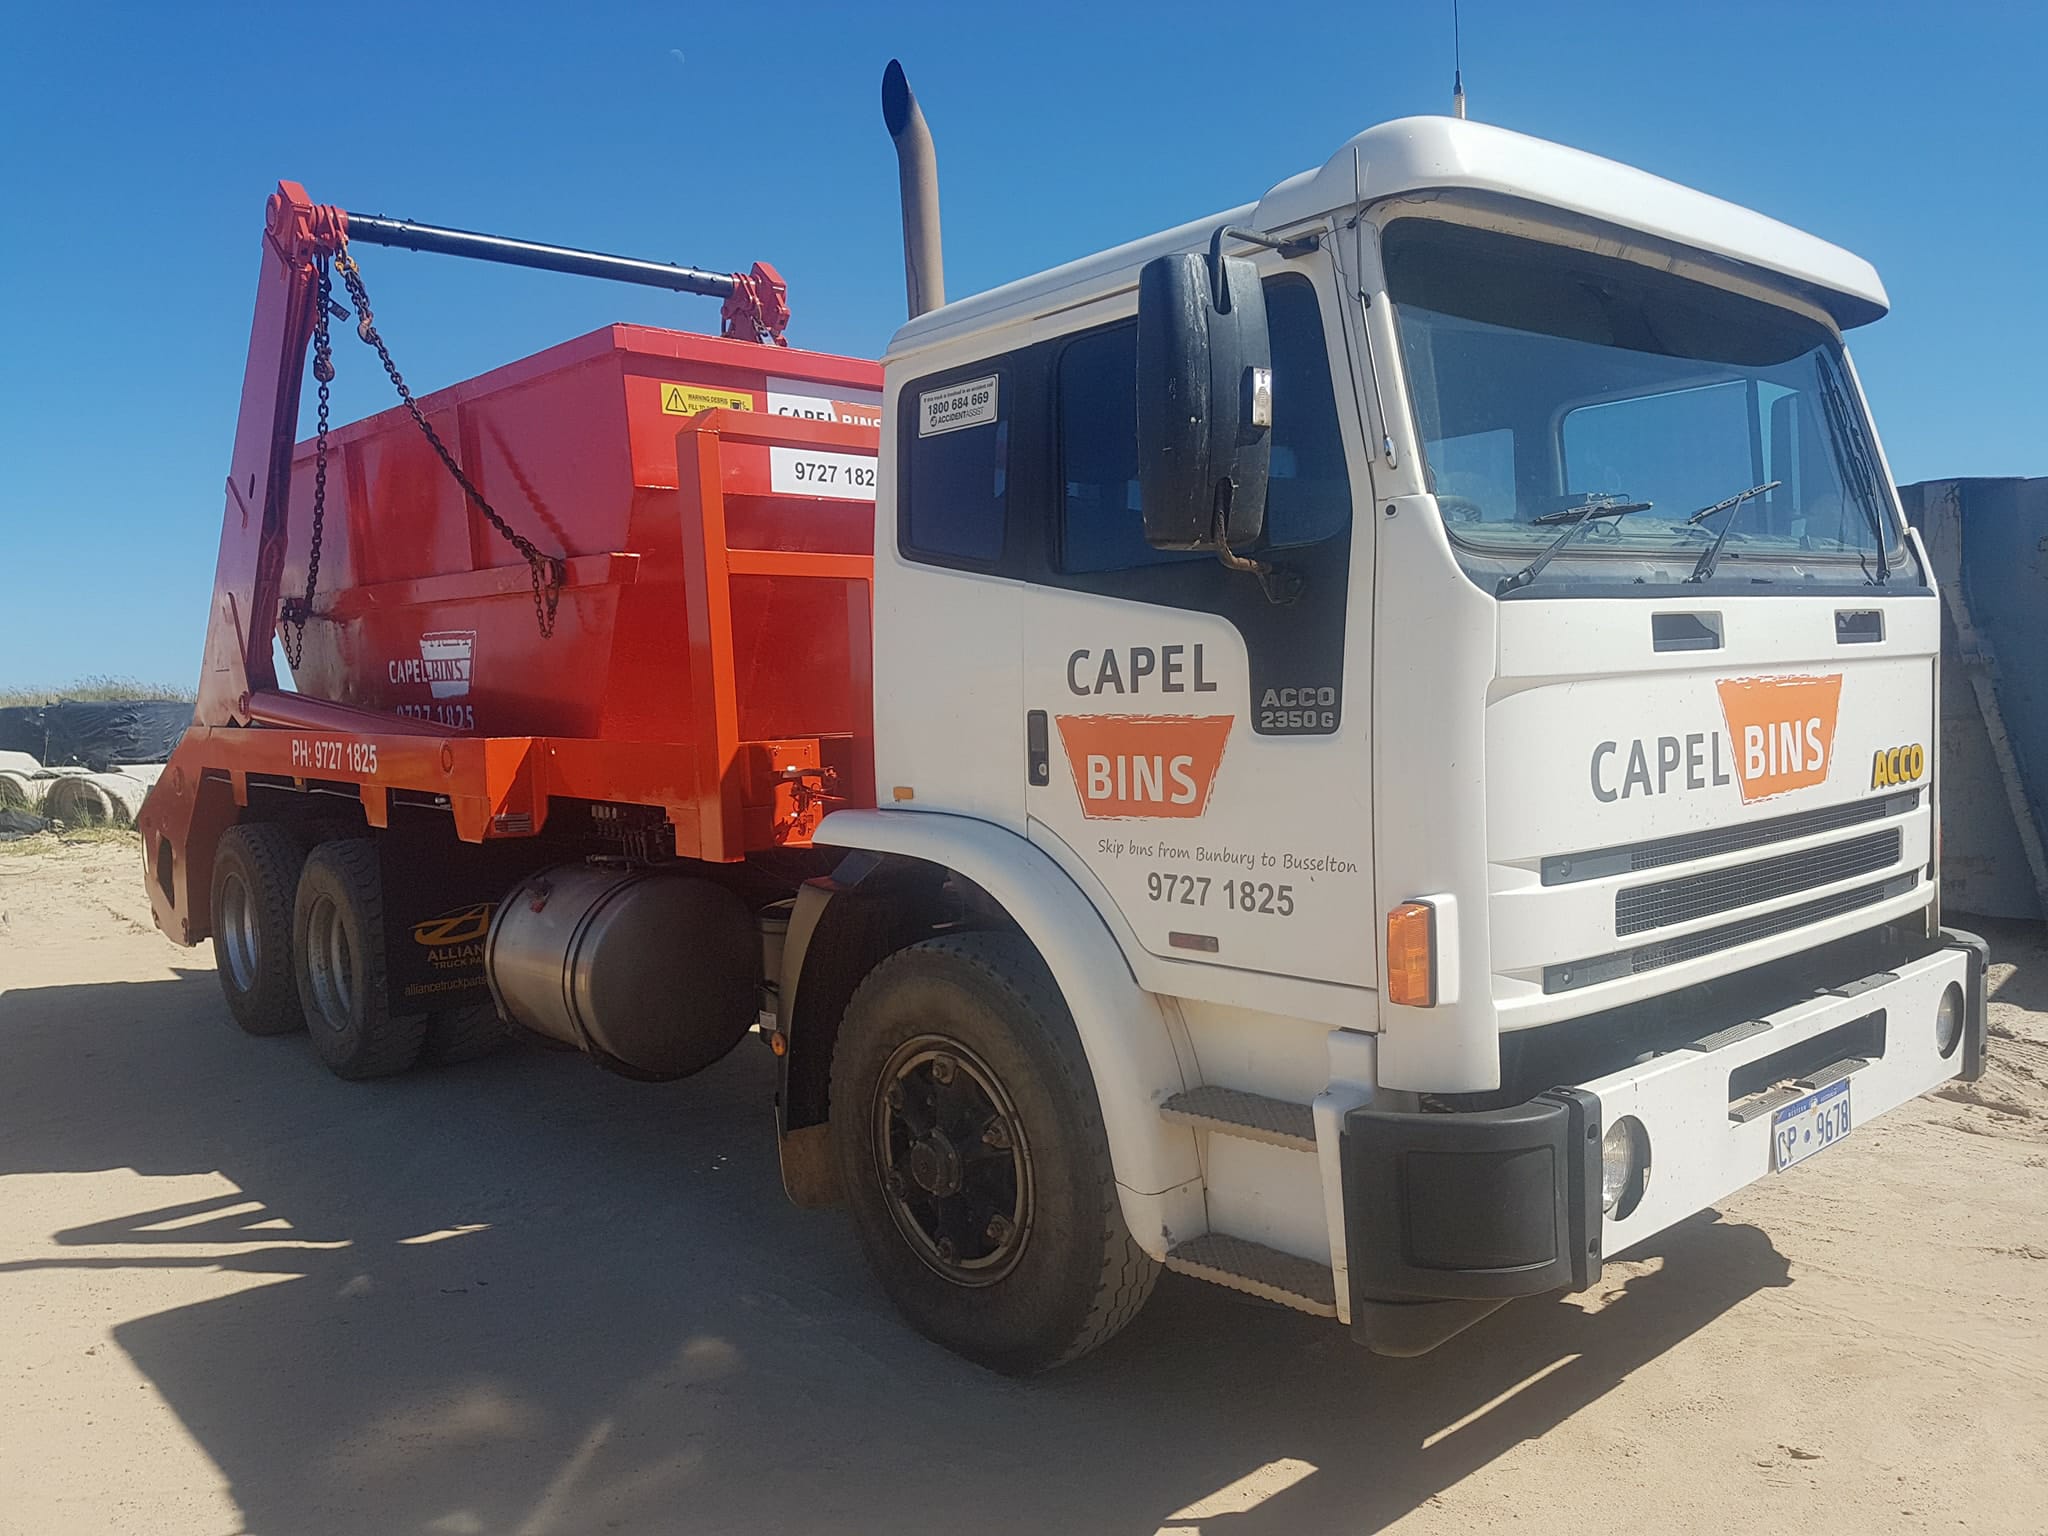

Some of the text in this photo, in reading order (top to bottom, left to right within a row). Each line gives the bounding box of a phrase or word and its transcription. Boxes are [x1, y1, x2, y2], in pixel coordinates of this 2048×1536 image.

[688, 394, 729, 405] WARNING DEBRIS
[928, 391, 989, 416] 1800 684 669
[794, 461, 875, 487] 9727 182
[388, 659, 466, 684] CAPEL BINS
[1066, 643, 1217, 696] CAPEL
[1260, 686, 1335, 708] ACCO
[1260, 711, 1334, 728] 2350 G
[291, 739, 378, 774] PH: 9727 1825
[1590, 717, 1824, 803] CAPEL BINS
[1871, 743, 1925, 791] ACCO
[1086, 754, 1198, 805] BINS
[1097, 838, 1358, 874] Skip bins from Bunbury to Busselton
[1147, 871, 1294, 916] 9727 1825
[433, 958, 467, 969] TRUCK
[1777, 1099, 1848, 1168] CP 9678
